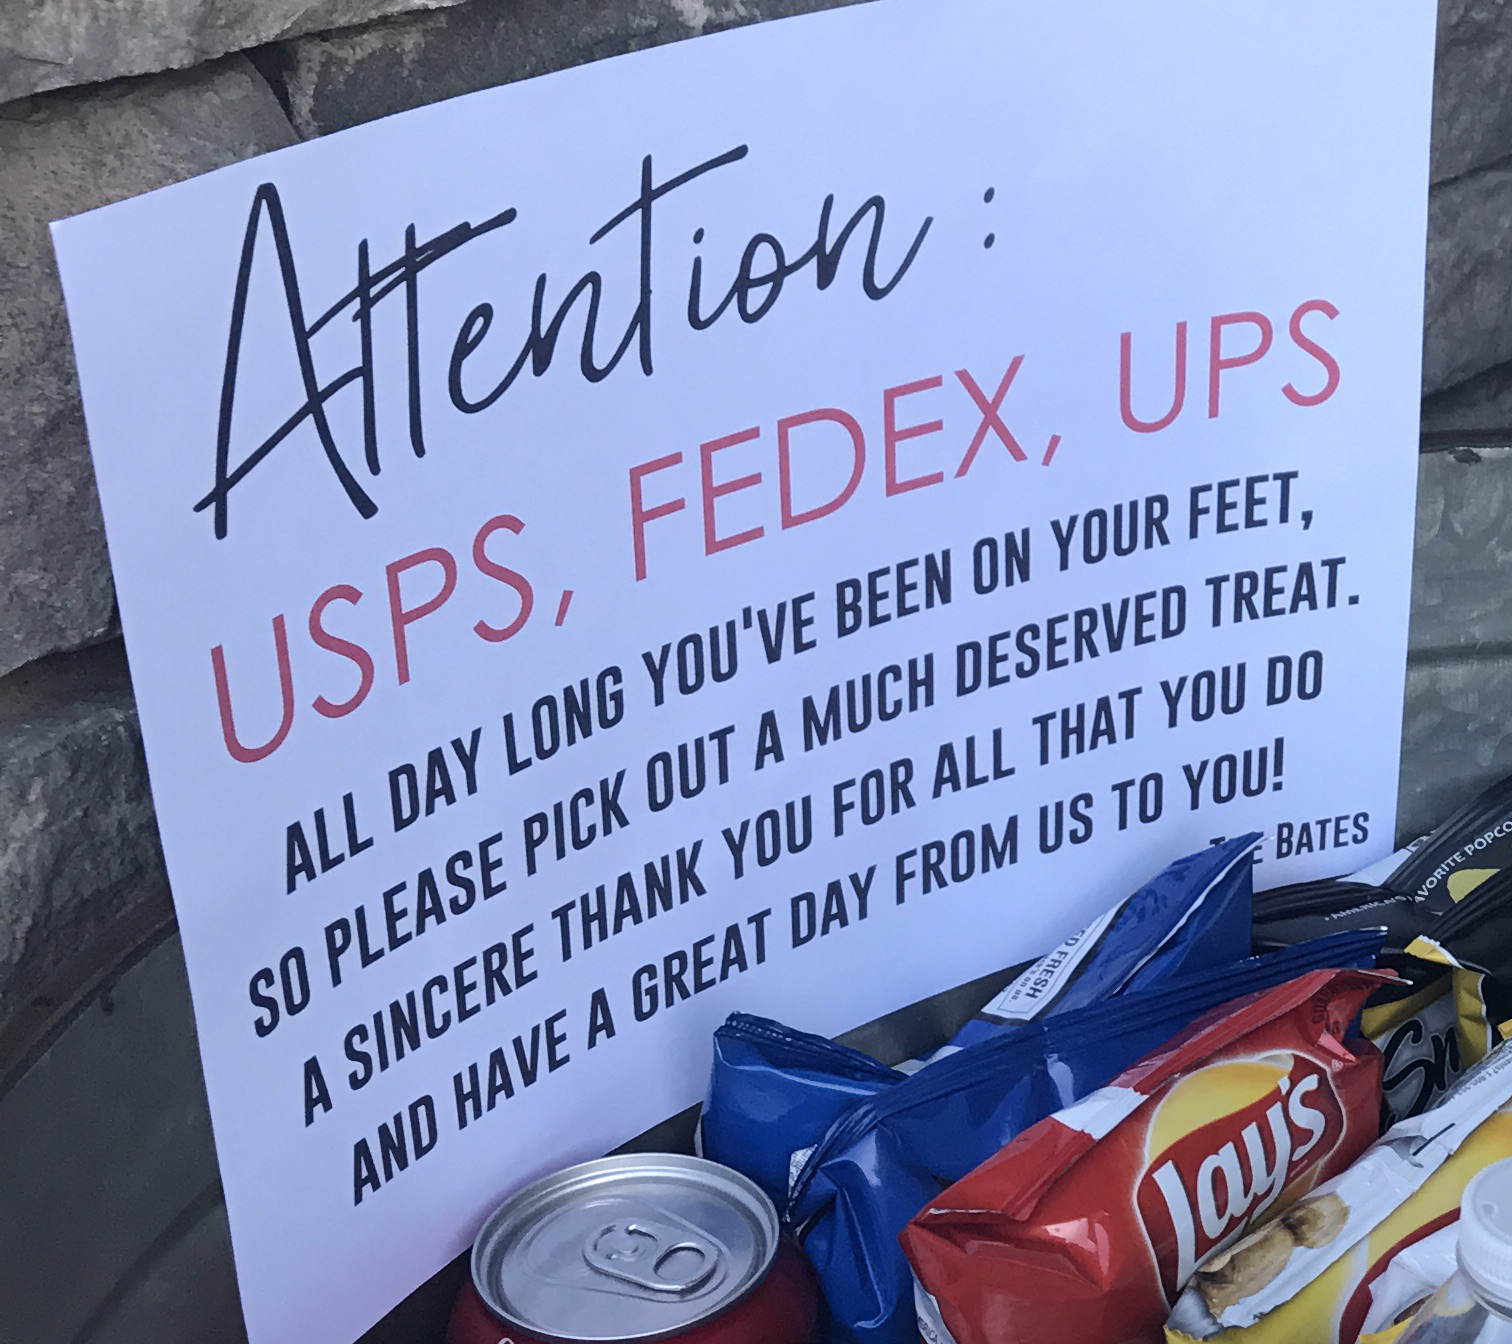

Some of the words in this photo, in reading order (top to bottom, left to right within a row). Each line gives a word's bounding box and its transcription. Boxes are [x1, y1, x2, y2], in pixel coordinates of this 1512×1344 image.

[211, 515, 574, 764] USPS,
[628, 354, 1062, 583] FEDEX,
[1119, 299, 1341, 434] UPS
[285, 791, 375, 896] ALL
[387, 726, 483, 834] DAY
[502, 665, 625, 777] LONG
[640, 590, 818, 708] YOU'VE
[835, 547, 952, 640] BEEN
[972, 526, 1031, 596] ON
[1049, 493, 1171, 573] YOUR
[1188, 470, 1314, 541] FEET,
[248, 945, 311, 1039] SO
[323, 831, 508, 989] PLEASE
[522, 767, 631, 878] PICK
[646, 723, 736, 813] OUT
[753, 709, 785, 772] A
[801, 652, 935, 753] MUCH
[955, 584, 1187, 698] DESERVED
[1204, 556, 1360, 629] TREAT.
[303, 1054, 334, 1129] A
[343, 922, 539, 1092] SINCERE
[550, 838, 708, 963] THANK
[720, 794, 813, 881] YOU
[832, 757, 917, 839] FOR
[931, 726, 1016, 800] ALL
[1031, 685, 1143, 767] THAT
[1159, 661, 1247, 729] YOU
[1265, 649, 1324, 708] DO
[353, 1094, 439, 1208] AND
[452, 1007, 571, 1131] HAVE
[586, 986, 617, 1051] A
[631, 906, 772, 1023] GREAT
[789, 863, 878, 950] DAY
[895, 813, 1019, 907] FROM
[1038, 792, 1094, 855] US
[1110, 771, 1164, 832] TO
[1181, 736, 1285, 812] YOU!
[1025, 950, 1069, 1000] FRESH
[1275, 811, 1370, 861] BATES
[1152, 1073, 1327, 1292] Lay's
